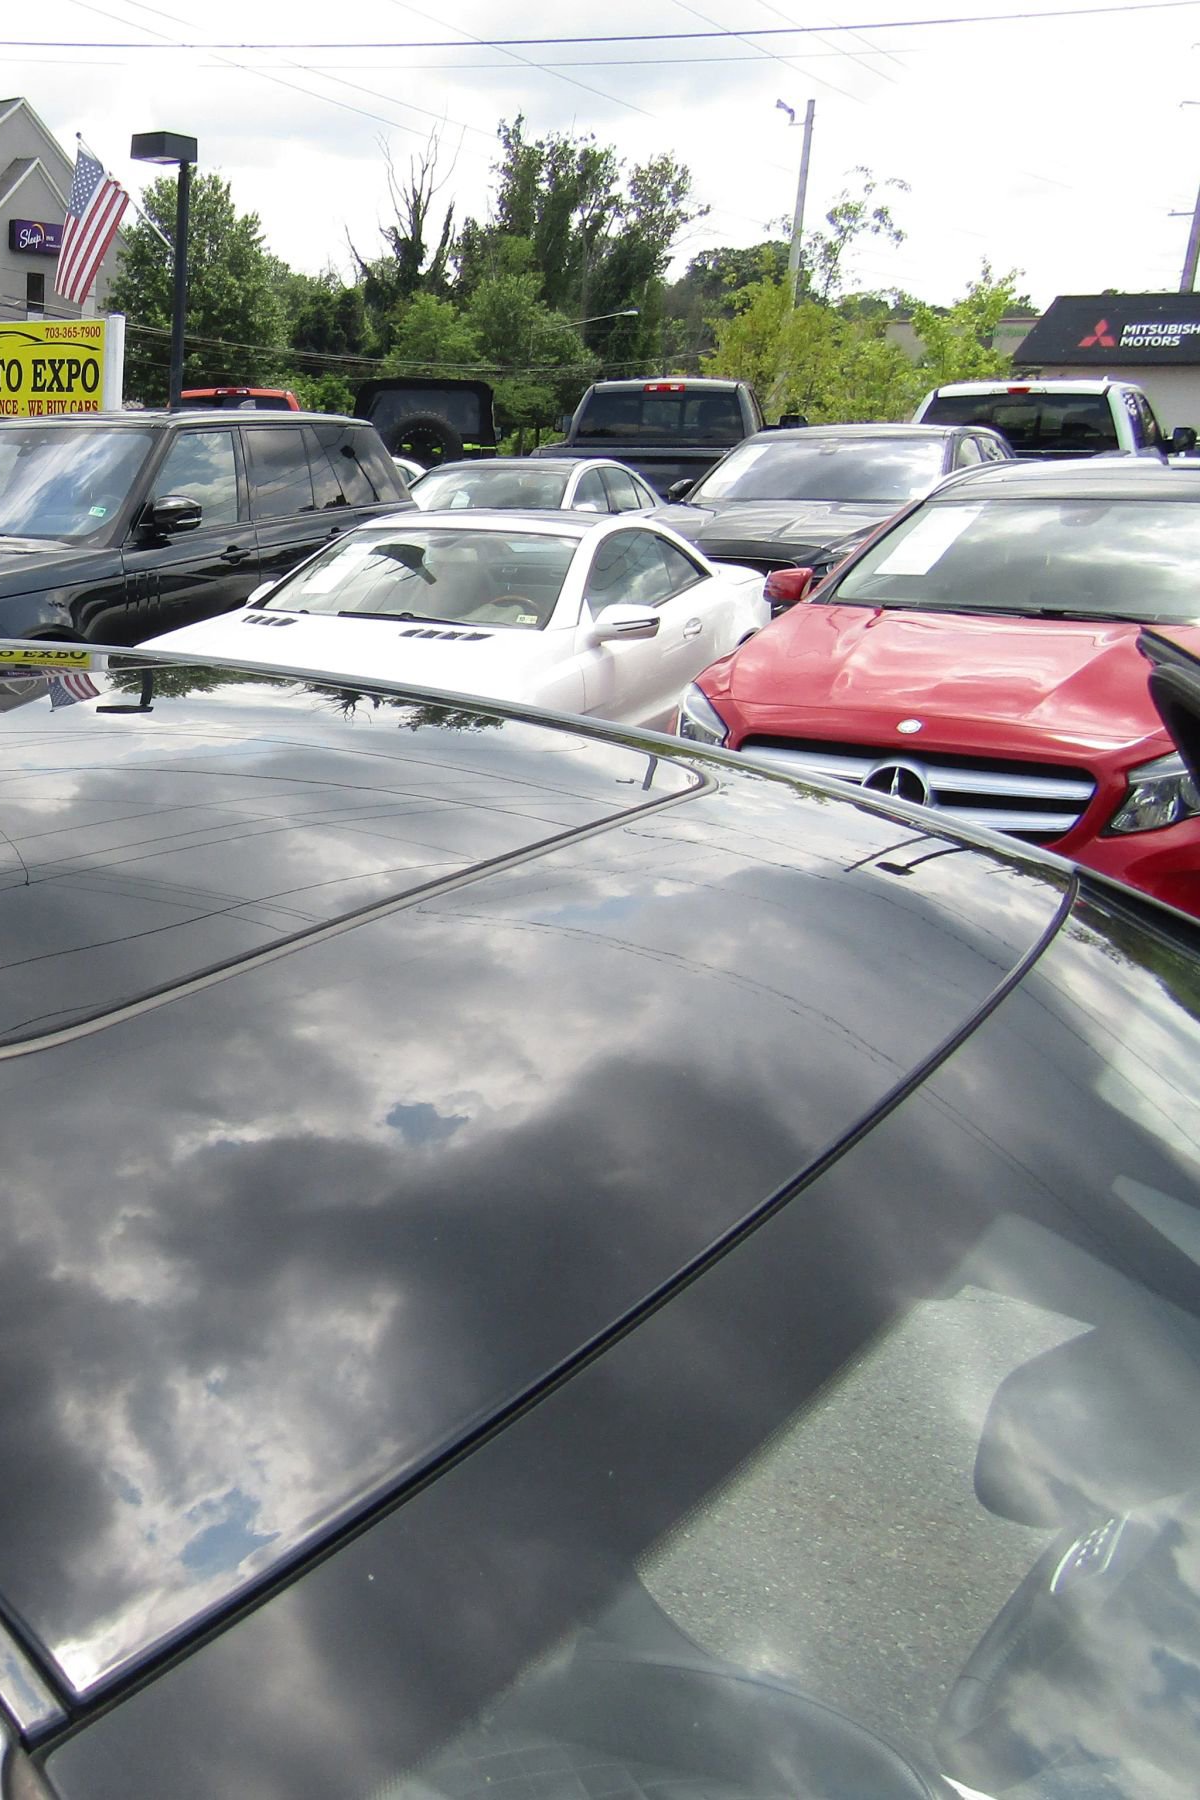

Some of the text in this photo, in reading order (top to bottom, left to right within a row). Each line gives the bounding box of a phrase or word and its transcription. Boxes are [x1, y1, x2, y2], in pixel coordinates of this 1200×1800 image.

[20, 229, 42, 249] Sleep
[45, 326, 101, 339] 703-365-7900
[1119, 335, 1181, 347] MOTORS
[31, 357, 100, 393] EXPO
[28, 400, 43, 416] WE
[46, 400, 67, 415] BUY
[70, 400, 98, 412] CARS
